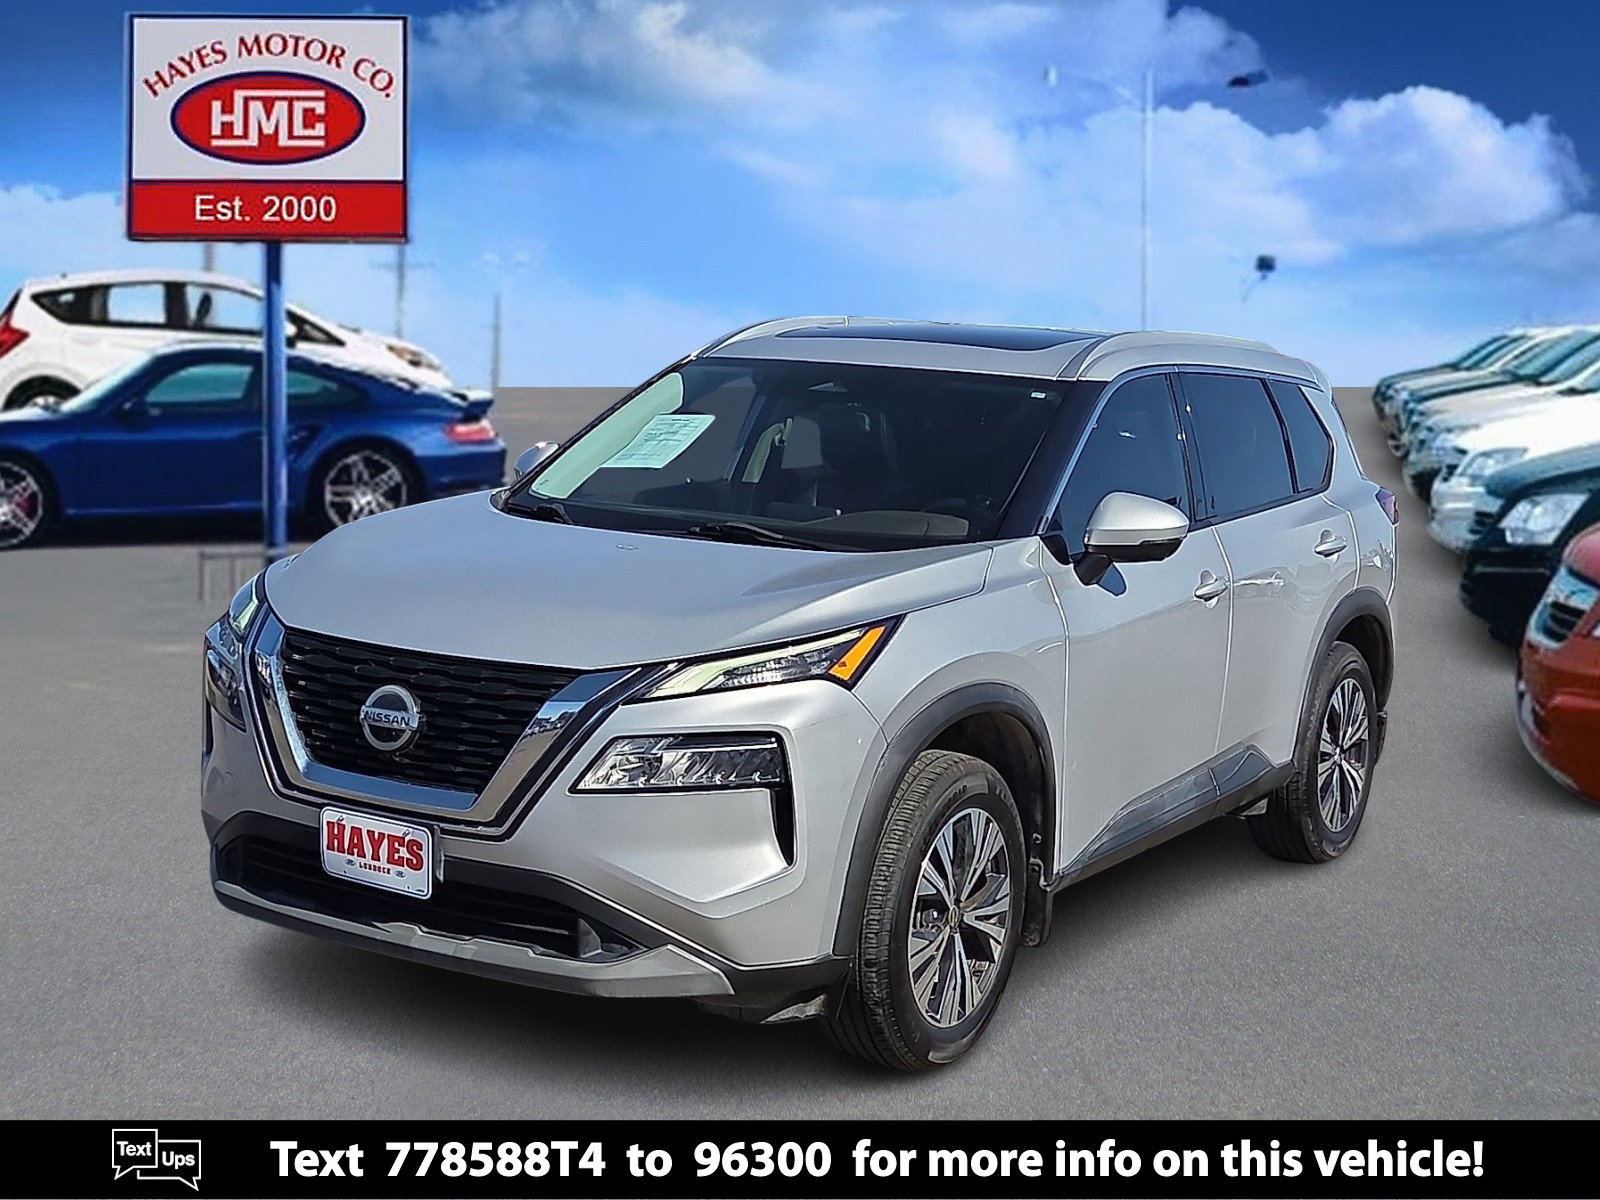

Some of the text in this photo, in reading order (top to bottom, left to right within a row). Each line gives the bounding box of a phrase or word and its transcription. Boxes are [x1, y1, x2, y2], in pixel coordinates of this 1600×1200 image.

[142, 33, 395, 99] HAYES MOTOR CO.
[211, 89, 326, 147] HMC
[195, 195, 337, 222] Est. 2000
[363, 709, 412, 728] NISSAN
[326, 820, 425, 872] HAYES
